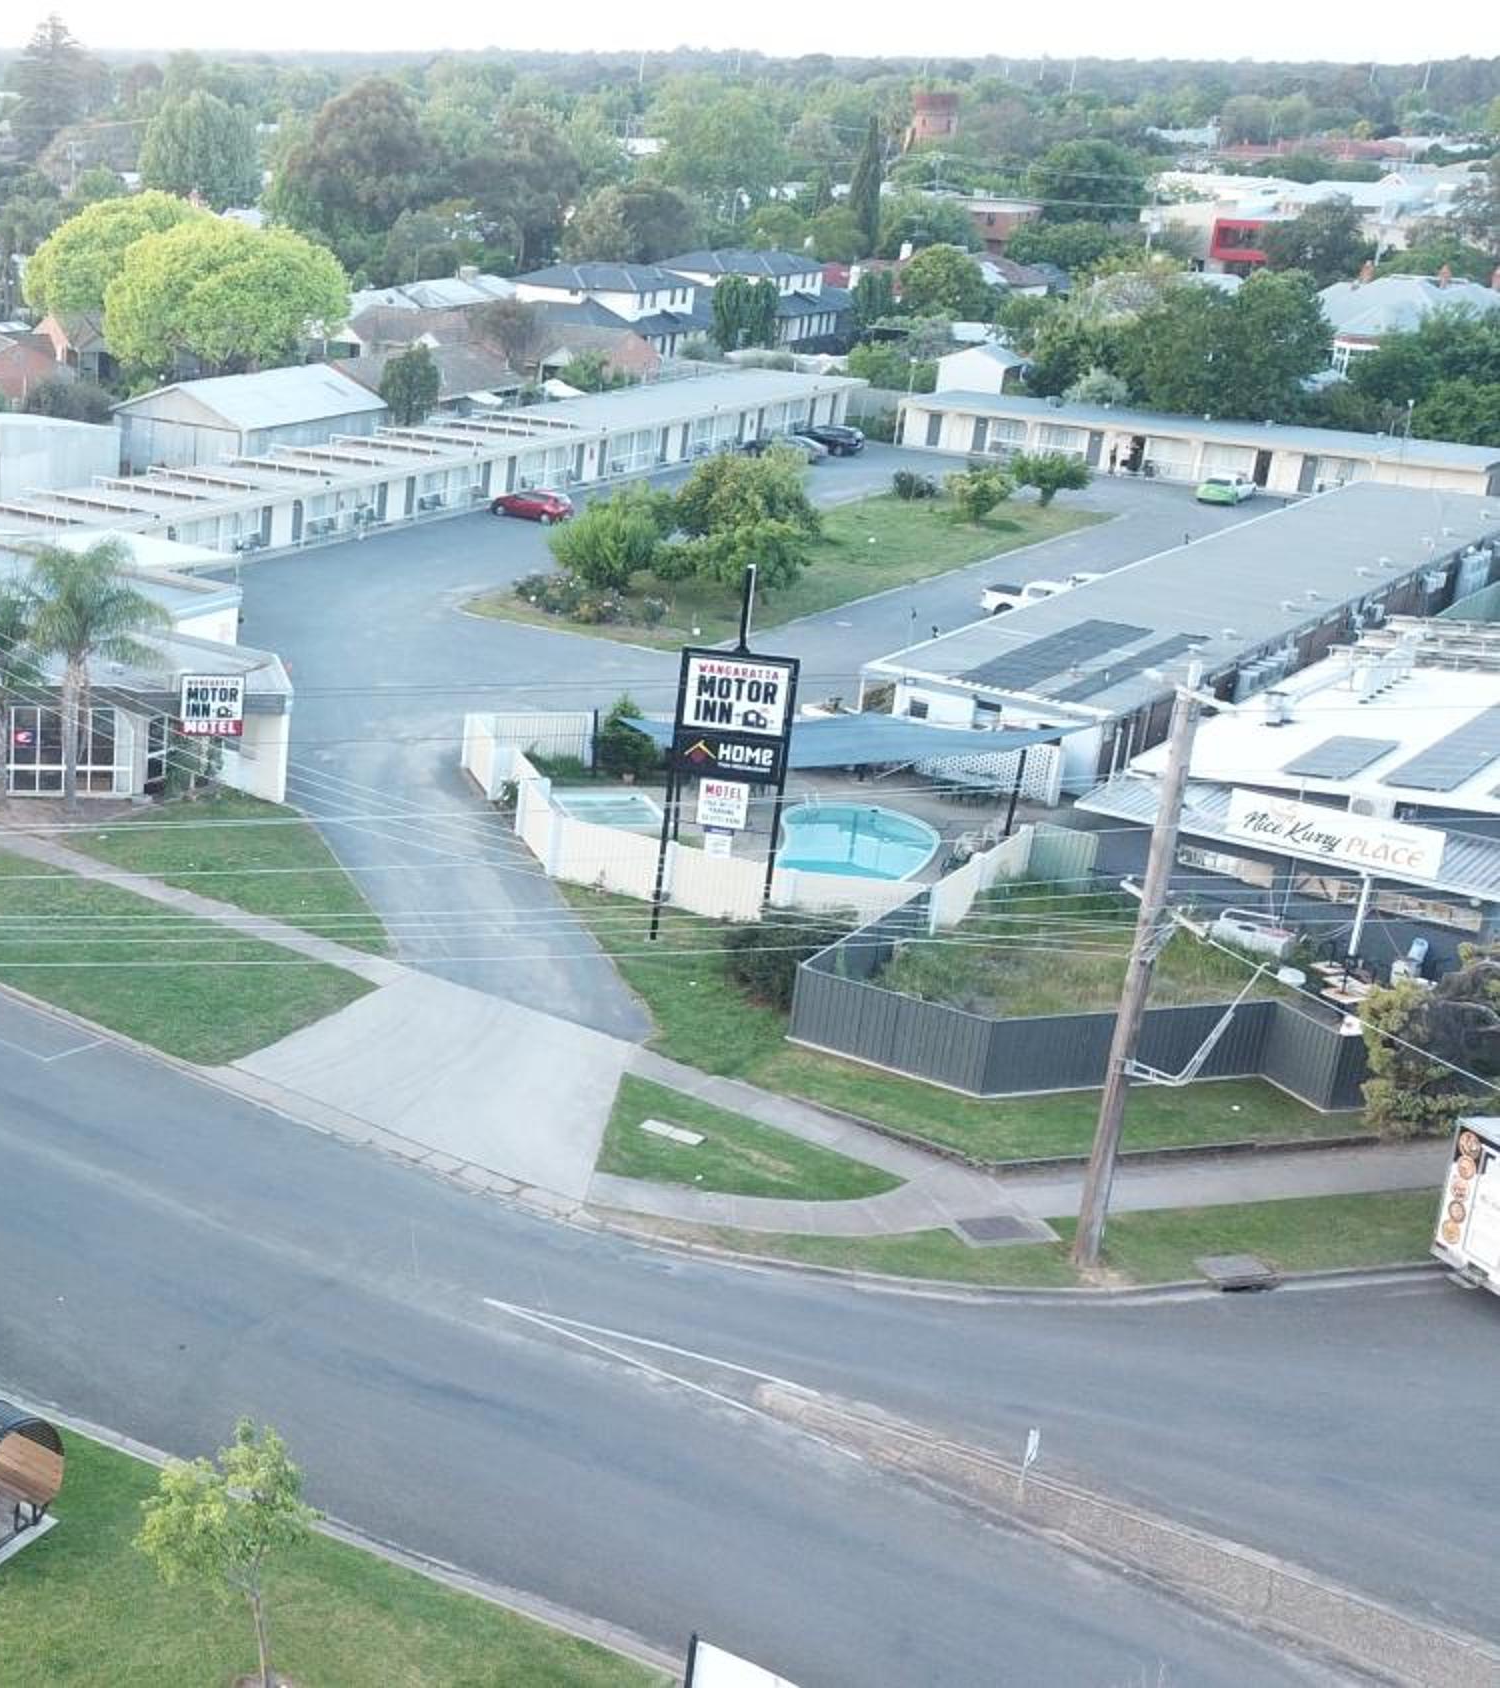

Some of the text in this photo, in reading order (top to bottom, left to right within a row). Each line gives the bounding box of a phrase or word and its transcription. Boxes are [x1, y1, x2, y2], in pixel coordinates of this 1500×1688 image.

[187, 688, 238, 702] MOTOR
[697, 675, 779, 705] MOTOR
[186, 703, 210, 717] INN
[694, 699, 733, 724] INN
[184, 721, 236, 734] MOTEL
[706, 784, 741, 800] MOTEL
[1243, 811, 1426, 866] Nice Kurry PLACE
